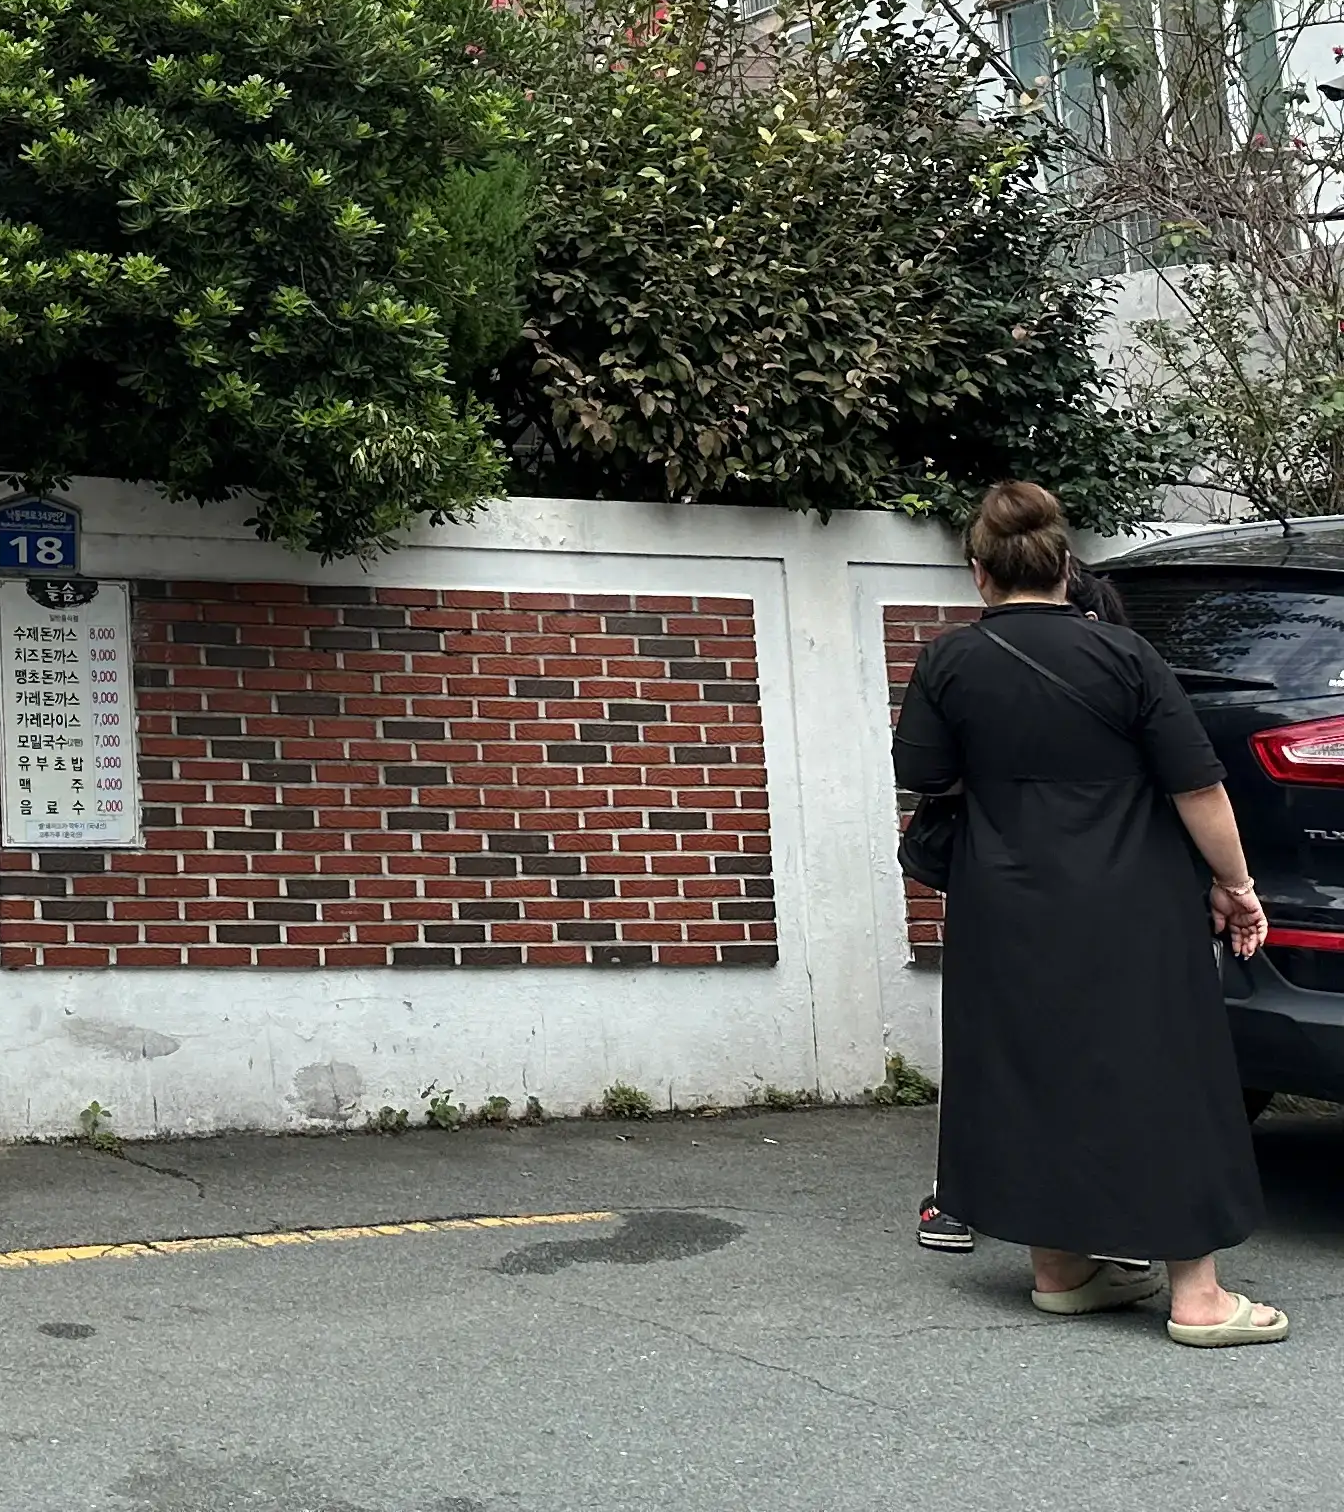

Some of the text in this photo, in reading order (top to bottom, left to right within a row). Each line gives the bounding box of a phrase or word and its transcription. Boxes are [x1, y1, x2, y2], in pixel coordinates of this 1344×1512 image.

[9, 536, 64, 565] 18
[89, 628, 115, 641] 8,000
[90, 649, 117, 662] 9,000
[91, 670, 117, 684] 9,000
[92, 691, 119, 705] 9,000
[16, 713, 120, 728] 카레라이스 7,000
[94, 735, 121, 748] 7,000
[95, 756, 122, 770] 5,000
[96, 778, 123, 791] 4,000
[97, 800, 124, 814] 2,000
